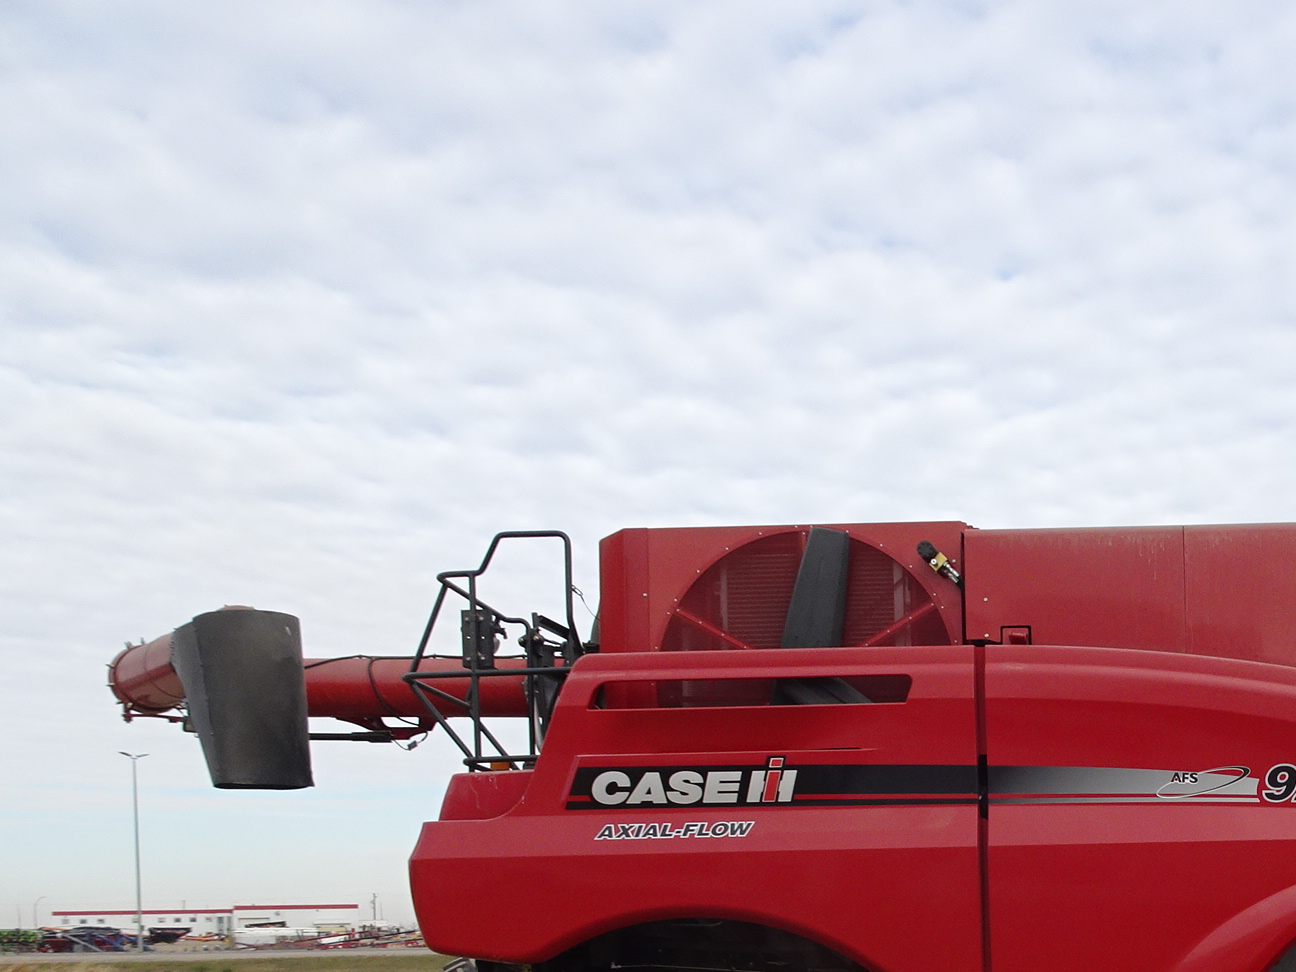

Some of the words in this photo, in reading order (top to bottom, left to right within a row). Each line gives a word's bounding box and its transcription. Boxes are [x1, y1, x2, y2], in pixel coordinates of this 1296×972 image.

[1171, 772, 1198, 784] AFS
[592, 771, 742, 805] CASE
[594, 821, 755, 840] AXIAL-FLOW
